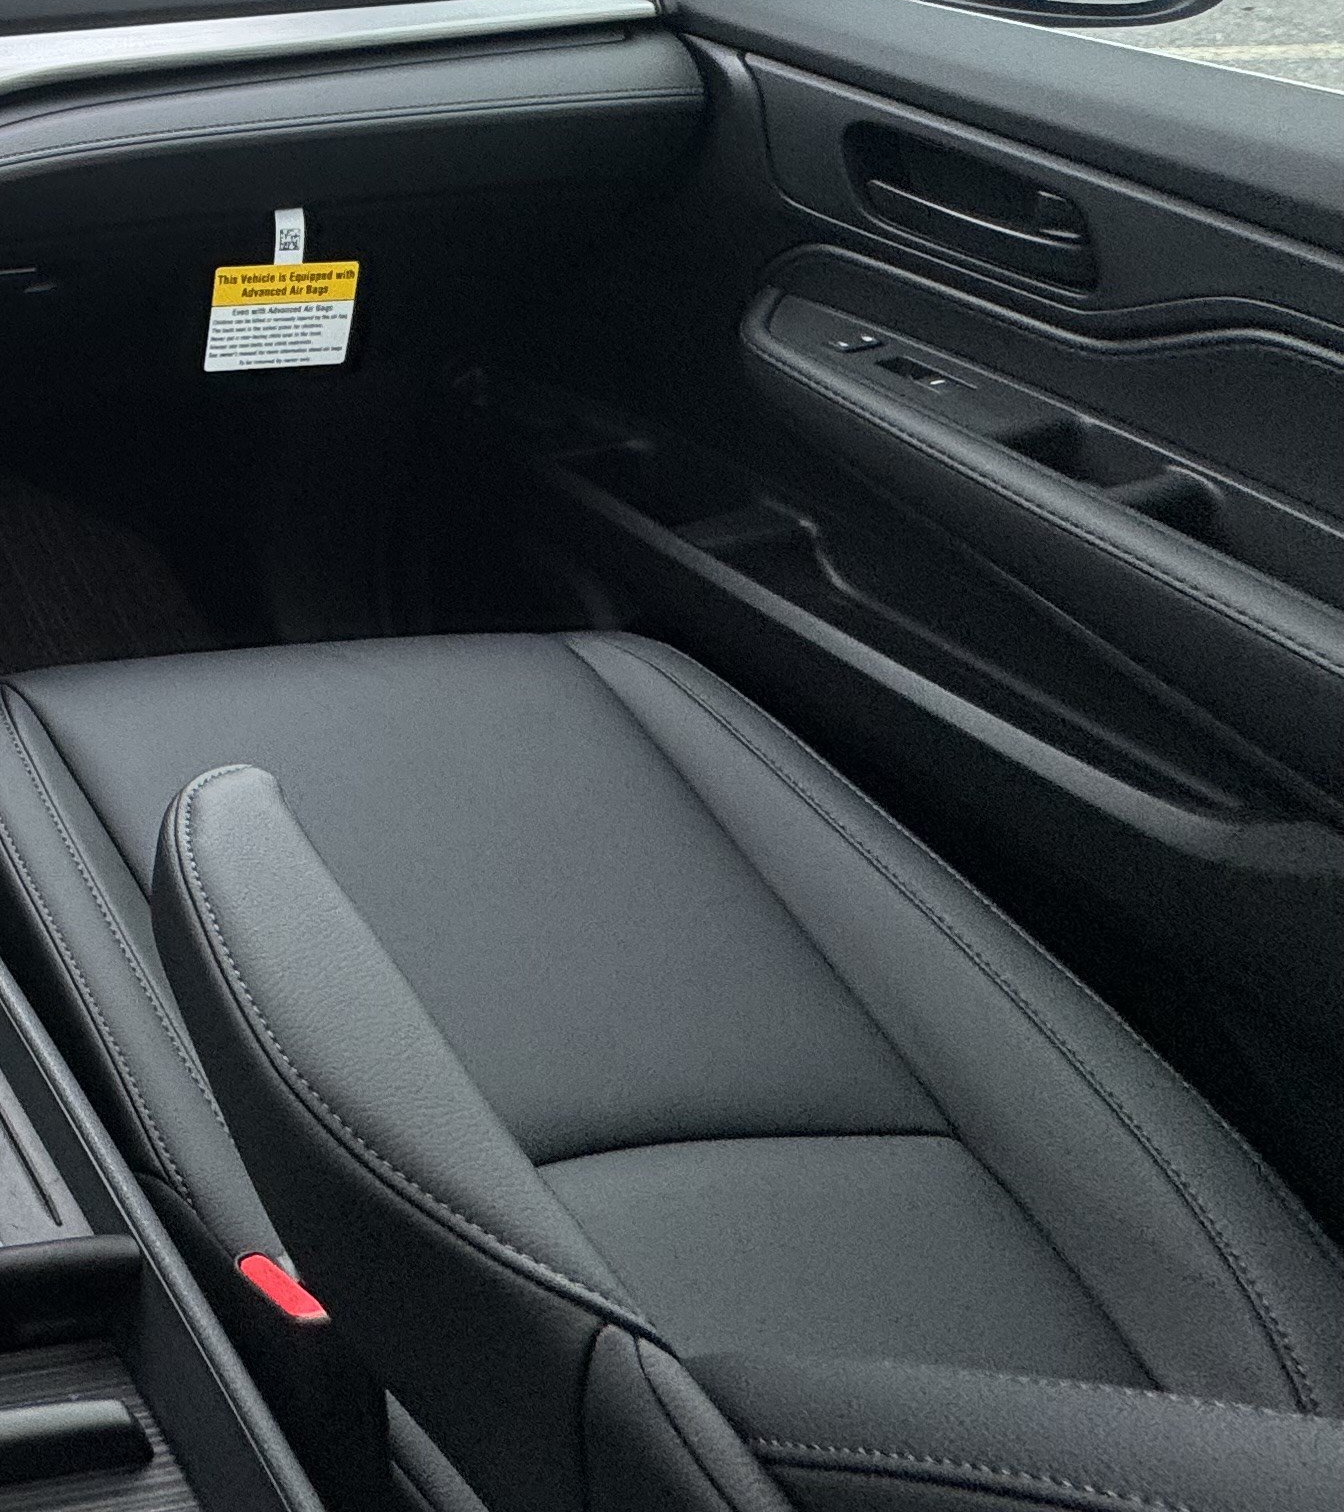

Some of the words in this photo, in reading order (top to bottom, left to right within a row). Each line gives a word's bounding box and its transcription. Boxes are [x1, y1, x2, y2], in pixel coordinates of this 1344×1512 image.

[217, 275, 238, 285] This
[241, 273, 276, 284] Vehicle
[278, 272, 287, 283] is
[289, 270, 333, 284] Equipped
[335, 269, 356, 280] with
[241, 287, 287, 297] Advanced
[289, 285, 304, 296] Air
[306, 285, 329, 296] Bags
[251, 306, 266, 315] with
[267, 305, 302, 314] Advanced
